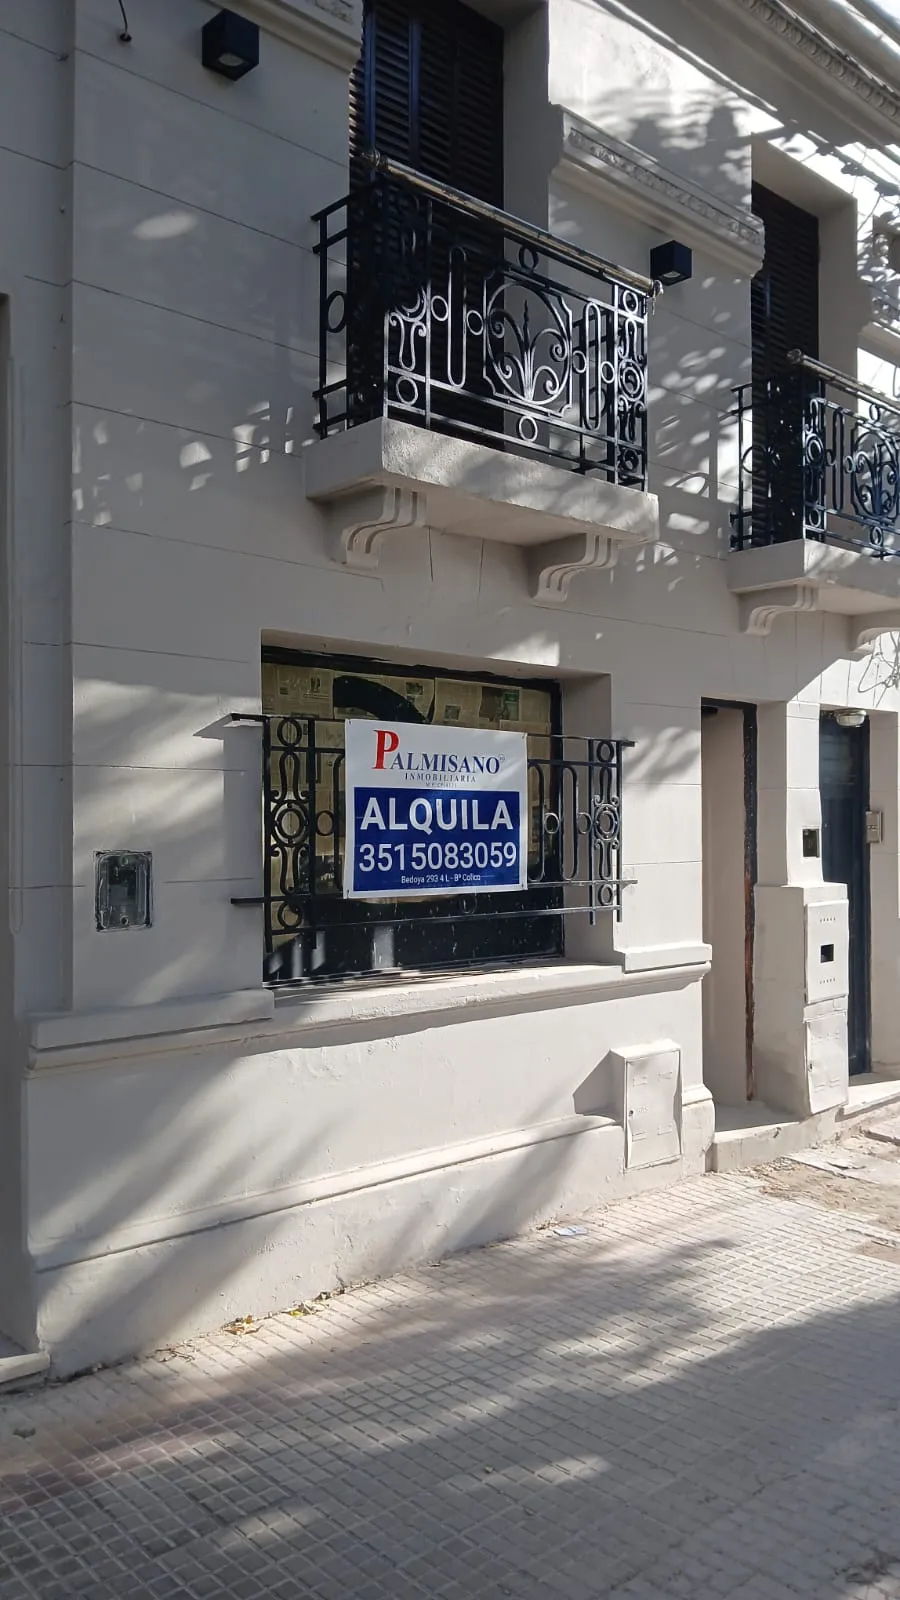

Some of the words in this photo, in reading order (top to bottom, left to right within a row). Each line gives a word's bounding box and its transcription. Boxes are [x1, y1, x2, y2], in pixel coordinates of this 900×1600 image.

[372, 729, 500, 775] PALMISANO
[405, 772, 476, 783] INMOBILIARIA
[360, 797, 514, 835] ALQUILA
[359, 842, 517, 872] 3515083059
[401, 874, 425, 885] Bedoya
[426, 874, 439, 883] 293
